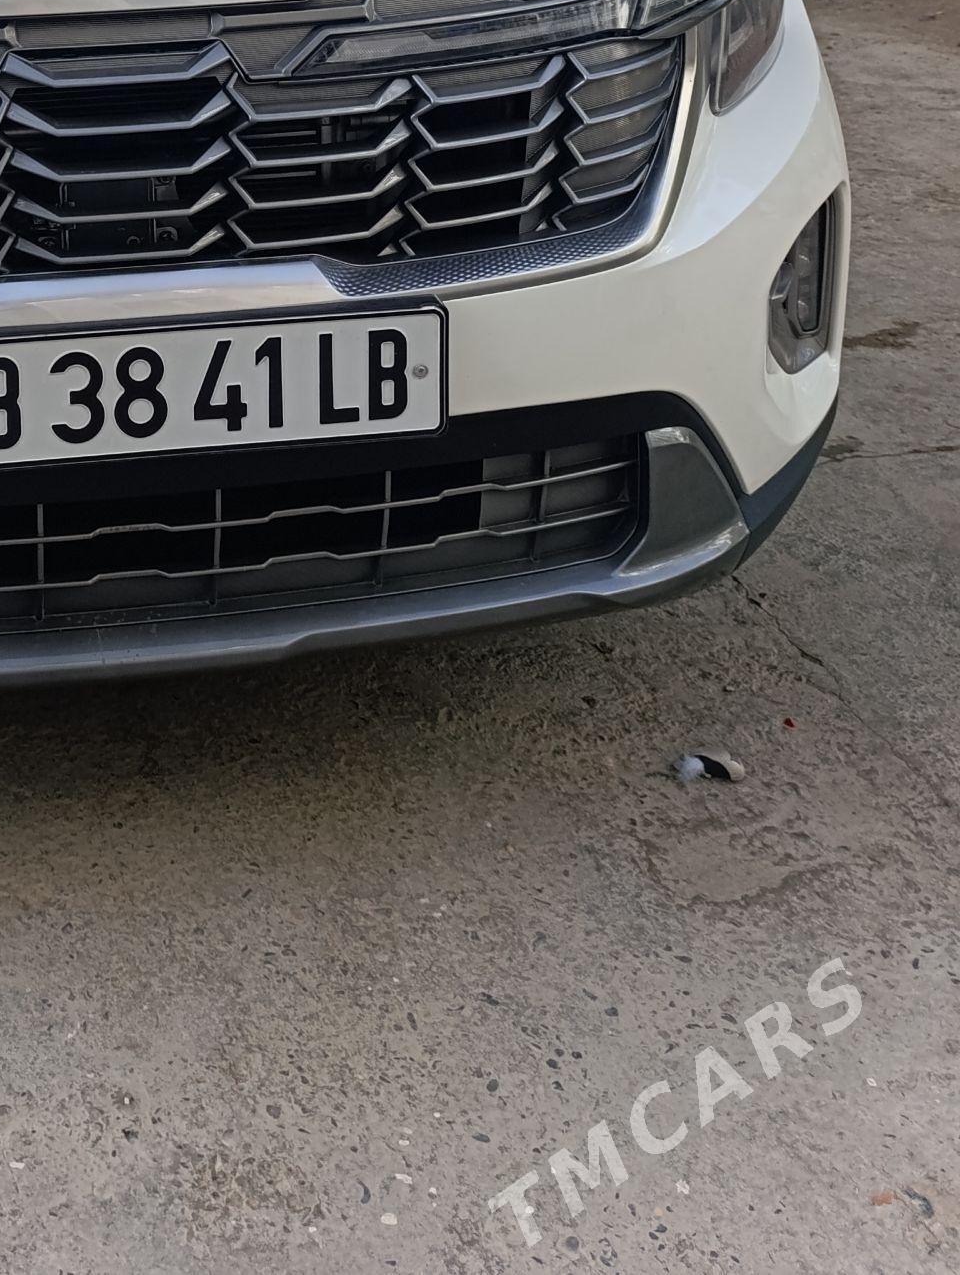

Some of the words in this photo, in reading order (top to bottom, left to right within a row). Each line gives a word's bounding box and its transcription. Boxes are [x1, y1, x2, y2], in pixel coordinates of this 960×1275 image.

[48, 345, 169, 445] 38
[192, 336, 284, 432] 41
[318, 328, 410, 426] LB
